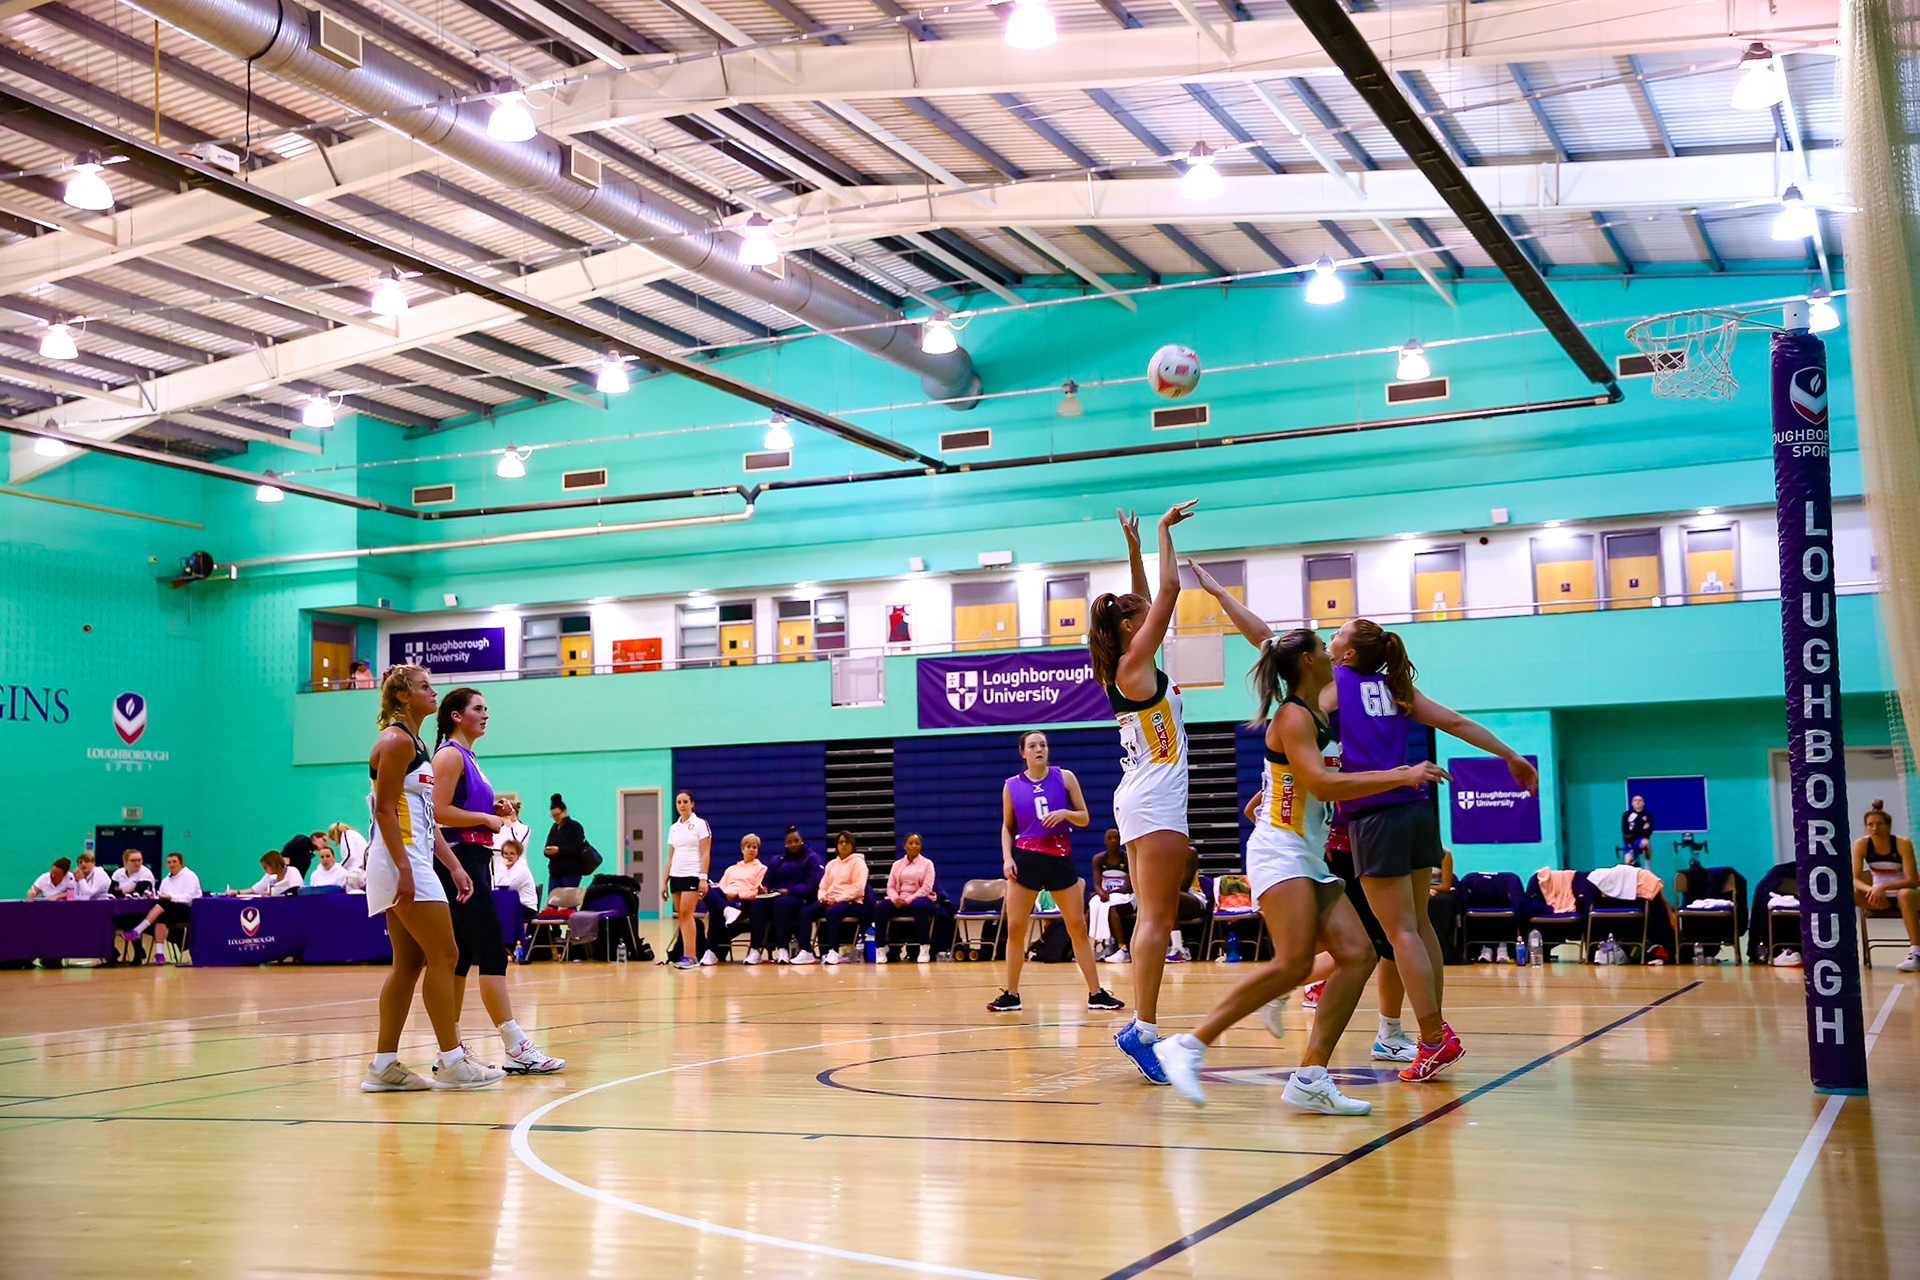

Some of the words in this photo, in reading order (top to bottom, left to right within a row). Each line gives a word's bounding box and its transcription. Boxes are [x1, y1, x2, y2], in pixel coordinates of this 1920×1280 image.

[425, 637, 490, 653] Loughborough
[425, 651, 470, 663] University
[982, 664, 1094, 687] Loughborough
[982, 686, 1060, 704] University
[86, 747, 169, 761] LOUGHBOROUGH
[105, 762, 152, 772] SPORT
[1801, 500, 1845, 1046] LOUGHBOROUGH
[1281, 785, 1293, 817] SPAR
[1475, 789, 1531, 800] Loughborough
[1475, 799, 1515, 808] University
